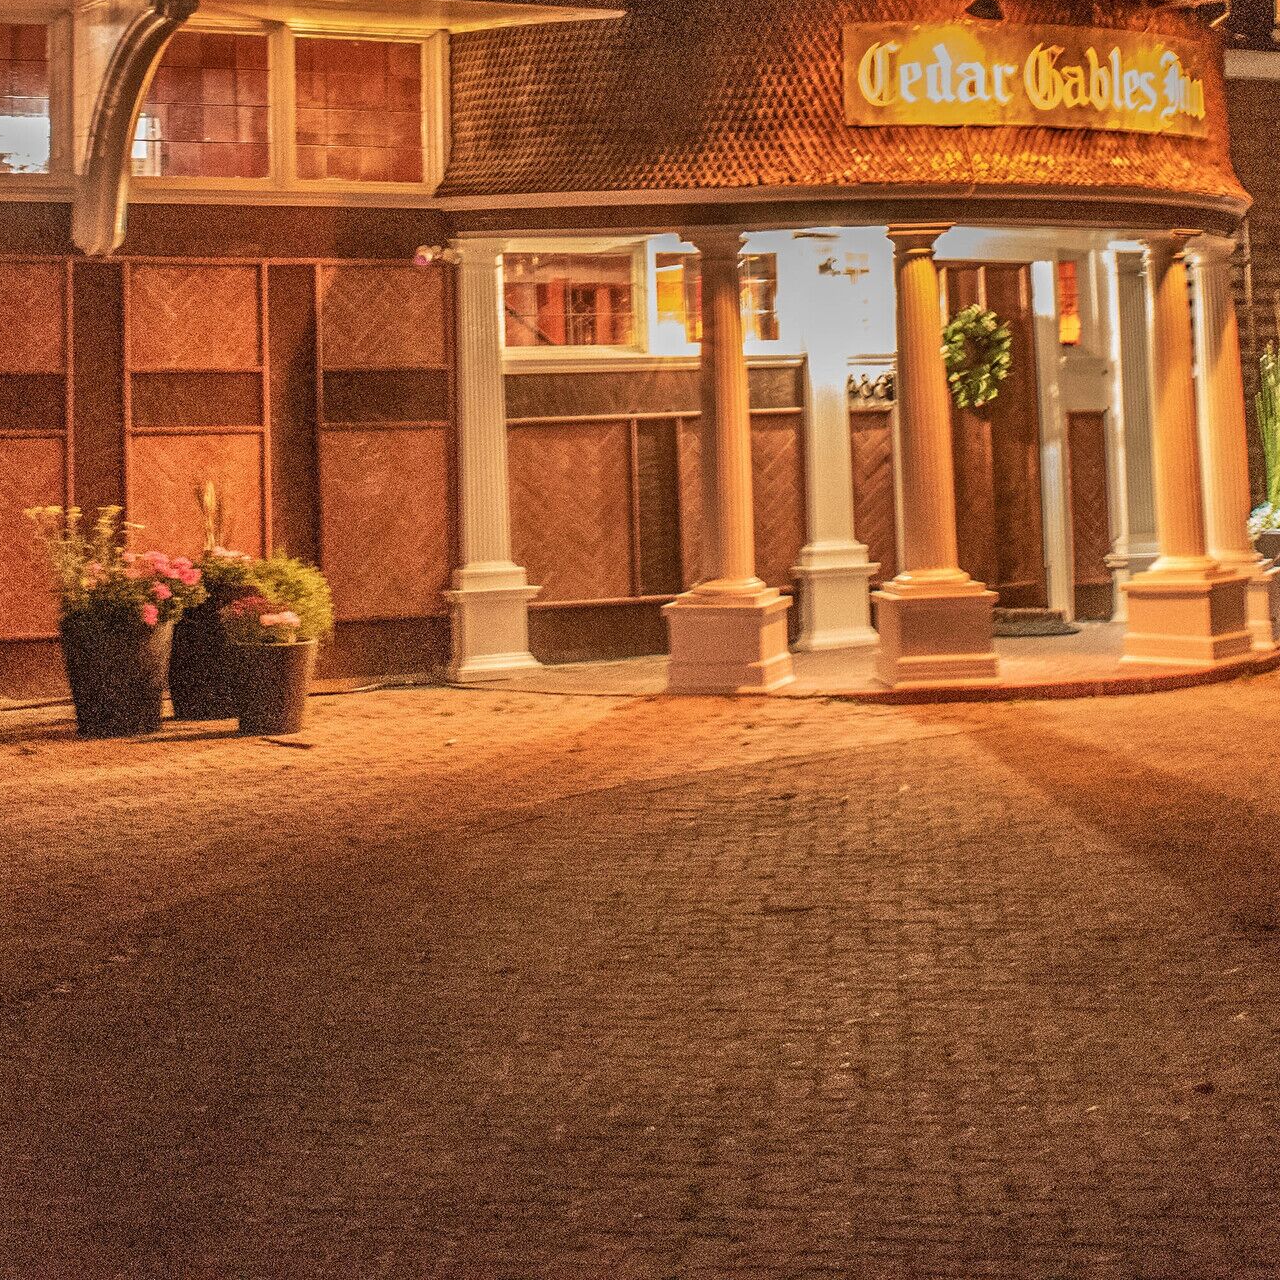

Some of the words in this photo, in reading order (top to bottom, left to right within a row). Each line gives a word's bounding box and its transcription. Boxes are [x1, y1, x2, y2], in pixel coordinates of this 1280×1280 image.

[857, 39, 1019, 107] Cedar
[1023, 41, 1157, 113] Gables
[1160, 50, 1206, 120] Inn
